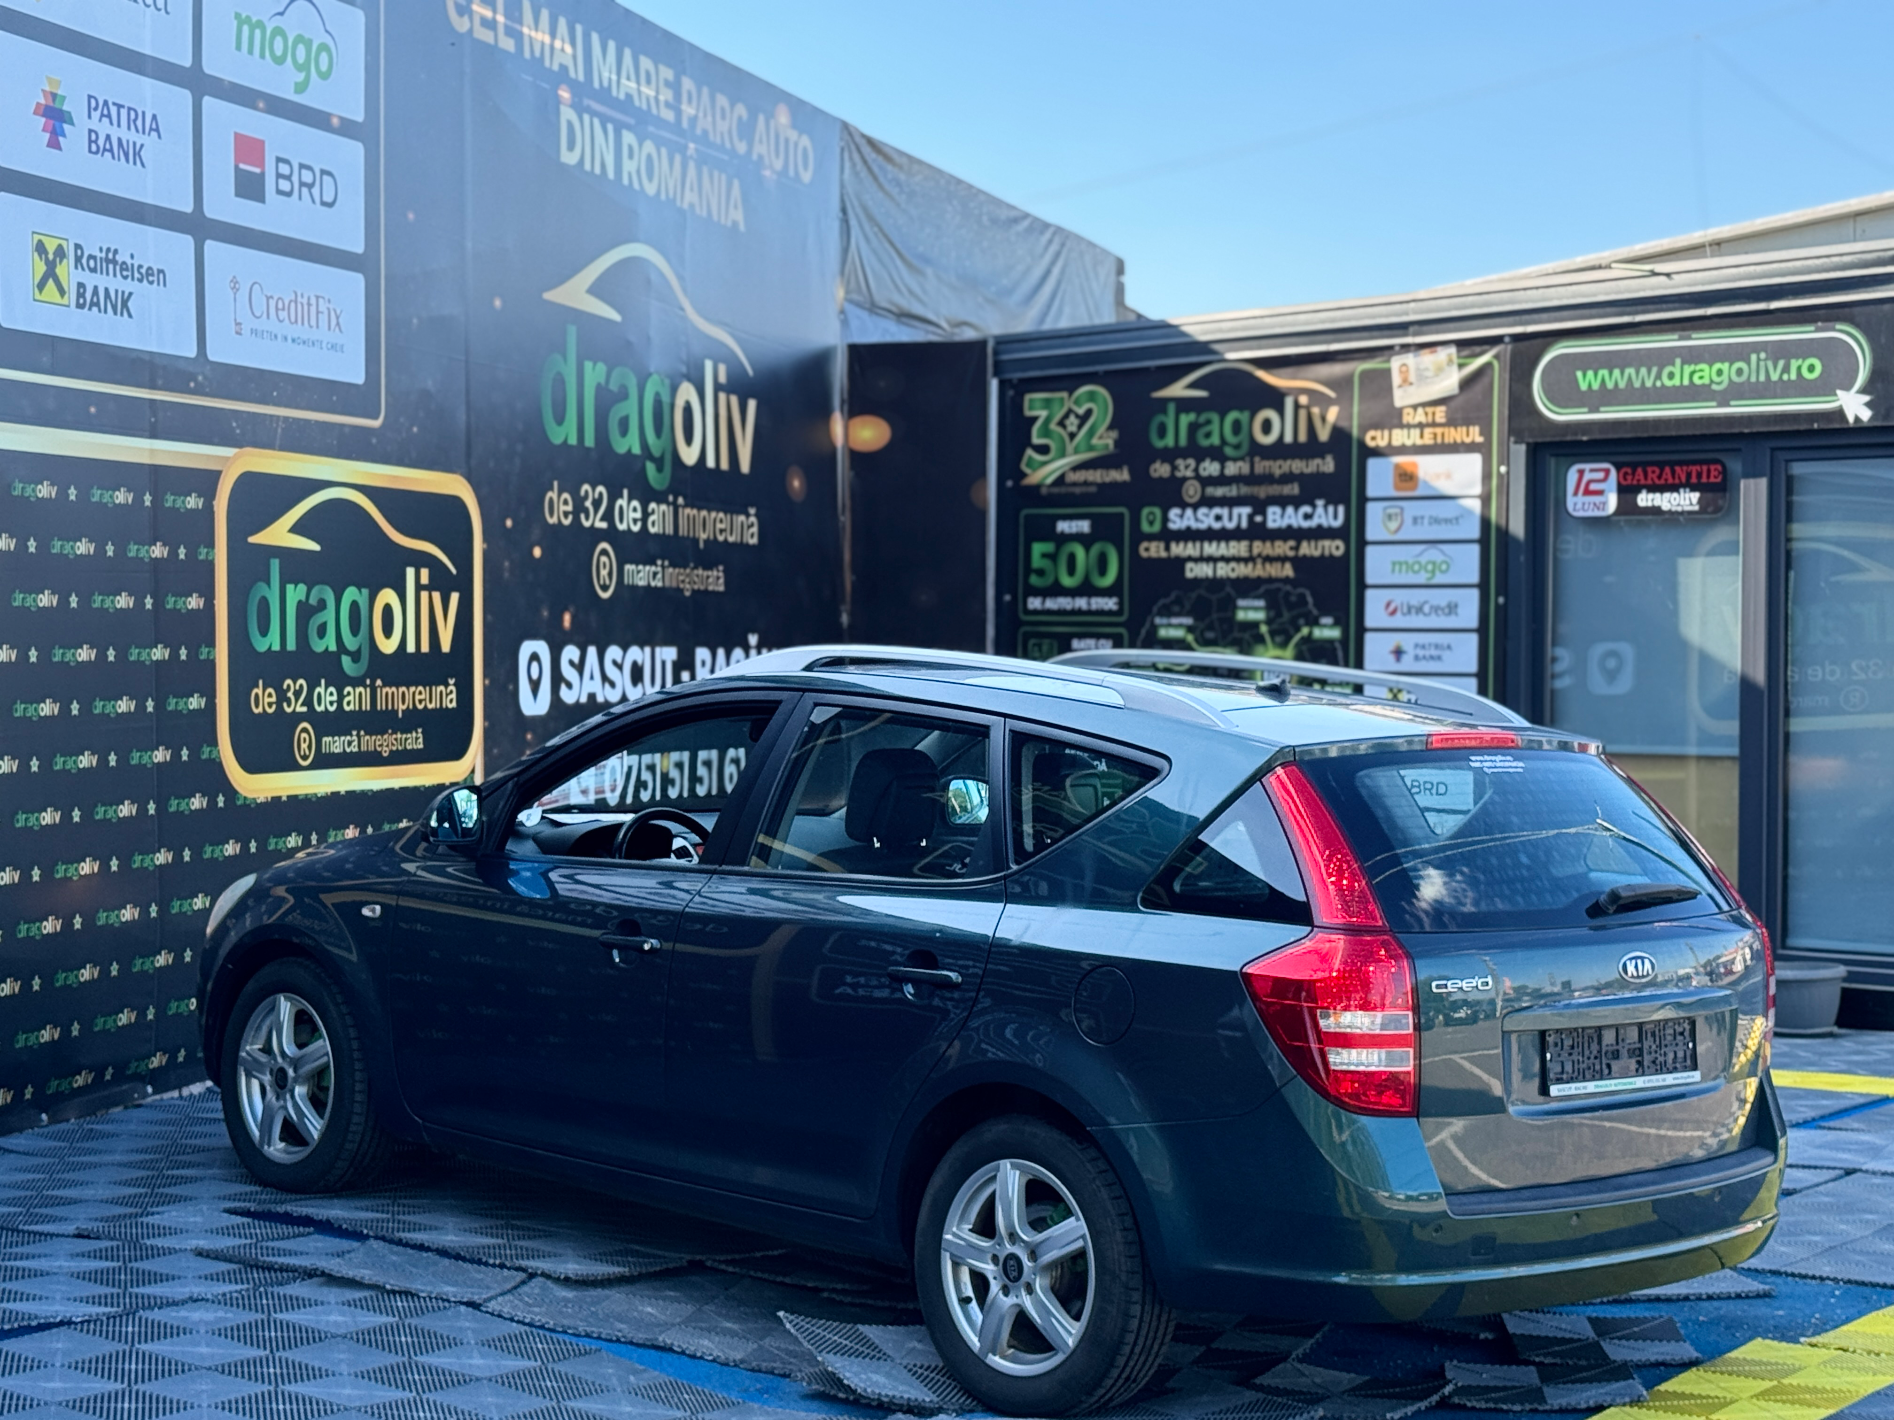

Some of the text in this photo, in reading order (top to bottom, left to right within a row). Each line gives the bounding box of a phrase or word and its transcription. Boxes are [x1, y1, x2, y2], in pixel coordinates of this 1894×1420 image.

[234, 11, 334, 95] mogo
[522, 0, 584, 82] MAI
[590, 30, 675, 124] MARE
[681, 75, 748, 155] PARC
[752, 113, 814, 184] AUTO
[87, 94, 162, 140] PATRIA
[87, 128, 146, 169] BANK
[560, 103, 746, 232] DIN ROMÂNIA
[275, 155, 338, 209] BRD
[74, 242, 167, 288] Raiffeisen
[75, 281, 134, 319] BANK
[248, 281, 343, 334] CreditFix
[1576, 352, 1822, 391] www.dragoliv.ro
[541, 324, 757, 491] dragoliv
[1150, 395, 1339, 458] dragoliv
[1402, 405, 1447, 425] RATE
[1020, 384, 1114, 475] 32
[1365, 425, 1484, 448] CU BULETINUL
[1150, 459, 1171, 478] de
[1174, 457, 1196, 477] 32
[1199, 458, 1221, 477] de
[1223, 457, 1250, 476] ani
[1572, 468, 1611, 497] 12
[1618, 464, 1723, 485] GARANTIE
[11, 480, 204, 512] dragoliv dragoliv dragoliv
[544, 480, 759, 549] de 32 de ani împreună
[1167, 507, 1252, 530] SASCUT
[1266, 499, 1345, 529] BACĂU
[1573, 501, 1607, 512] LUNI
[1637, 488, 1700, 511] dragoliv
[51, 537, 95, 559] dragoliv
[127, 541, 169, 562] dragoliv
[1028, 541, 1120, 588] 500
[1138, 539, 1345, 559] CEL MAI MARE PARC AUTO
[624, 559, 664, 588] marcă
[664, 560, 725, 597] înregistrată
[1185, 558, 1295, 579] DIN ROMÂNIA
[1391, 559, 1451, 581] mogo
[11, 589, 205, 613] dragoliv dragoliv dragoliv
[247, 558, 460, 677] dragoliv
[1401, 601, 1459, 617] UniCredit
[52, 644, 96, 666] dragoliv
[128, 643, 170, 665] dragoliv
[560, 644, 677, 704] SASCUT
[13, 692, 206, 721] dragoliv dragoliv dragoliv
[251, 677, 457, 718] de 32 de ani împreună
[53, 751, 98, 773] dragoliv
[129, 746, 171, 768] dragoliv
[321, 730, 358, 753] marcă
[360, 728, 424, 757] înregistrată
[668, 751, 690, 799] 51
[696, 749, 718, 797] 51
[1410, 779, 1448, 797] BRD
[14, 807, 61, 830] dragoliv
[94, 800, 138, 822] dragoliv
[168, 793, 208, 814] dragoliv
[54, 857, 100, 880] dragoliv
[131, 848, 173, 870] dragoliv
[203, 839, 241, 862] dragoliv
[268, 832, 303, 852] dragoliv
[16, 893, 211, 939] dragoliv dragoliv dragoliv
[54, 963, 100, 988] dragoliv
[132, 950, 174, 973] dragoliv
[1626, 959, 1653, 977] KIA
[14, 1024, 60, 1048] dragoliv
[93, 1008, 137, 1032] dragoliv
[46, 1069, 95, 1094] dragoliv
[126, 1051, 169, 1075] dragoliv
